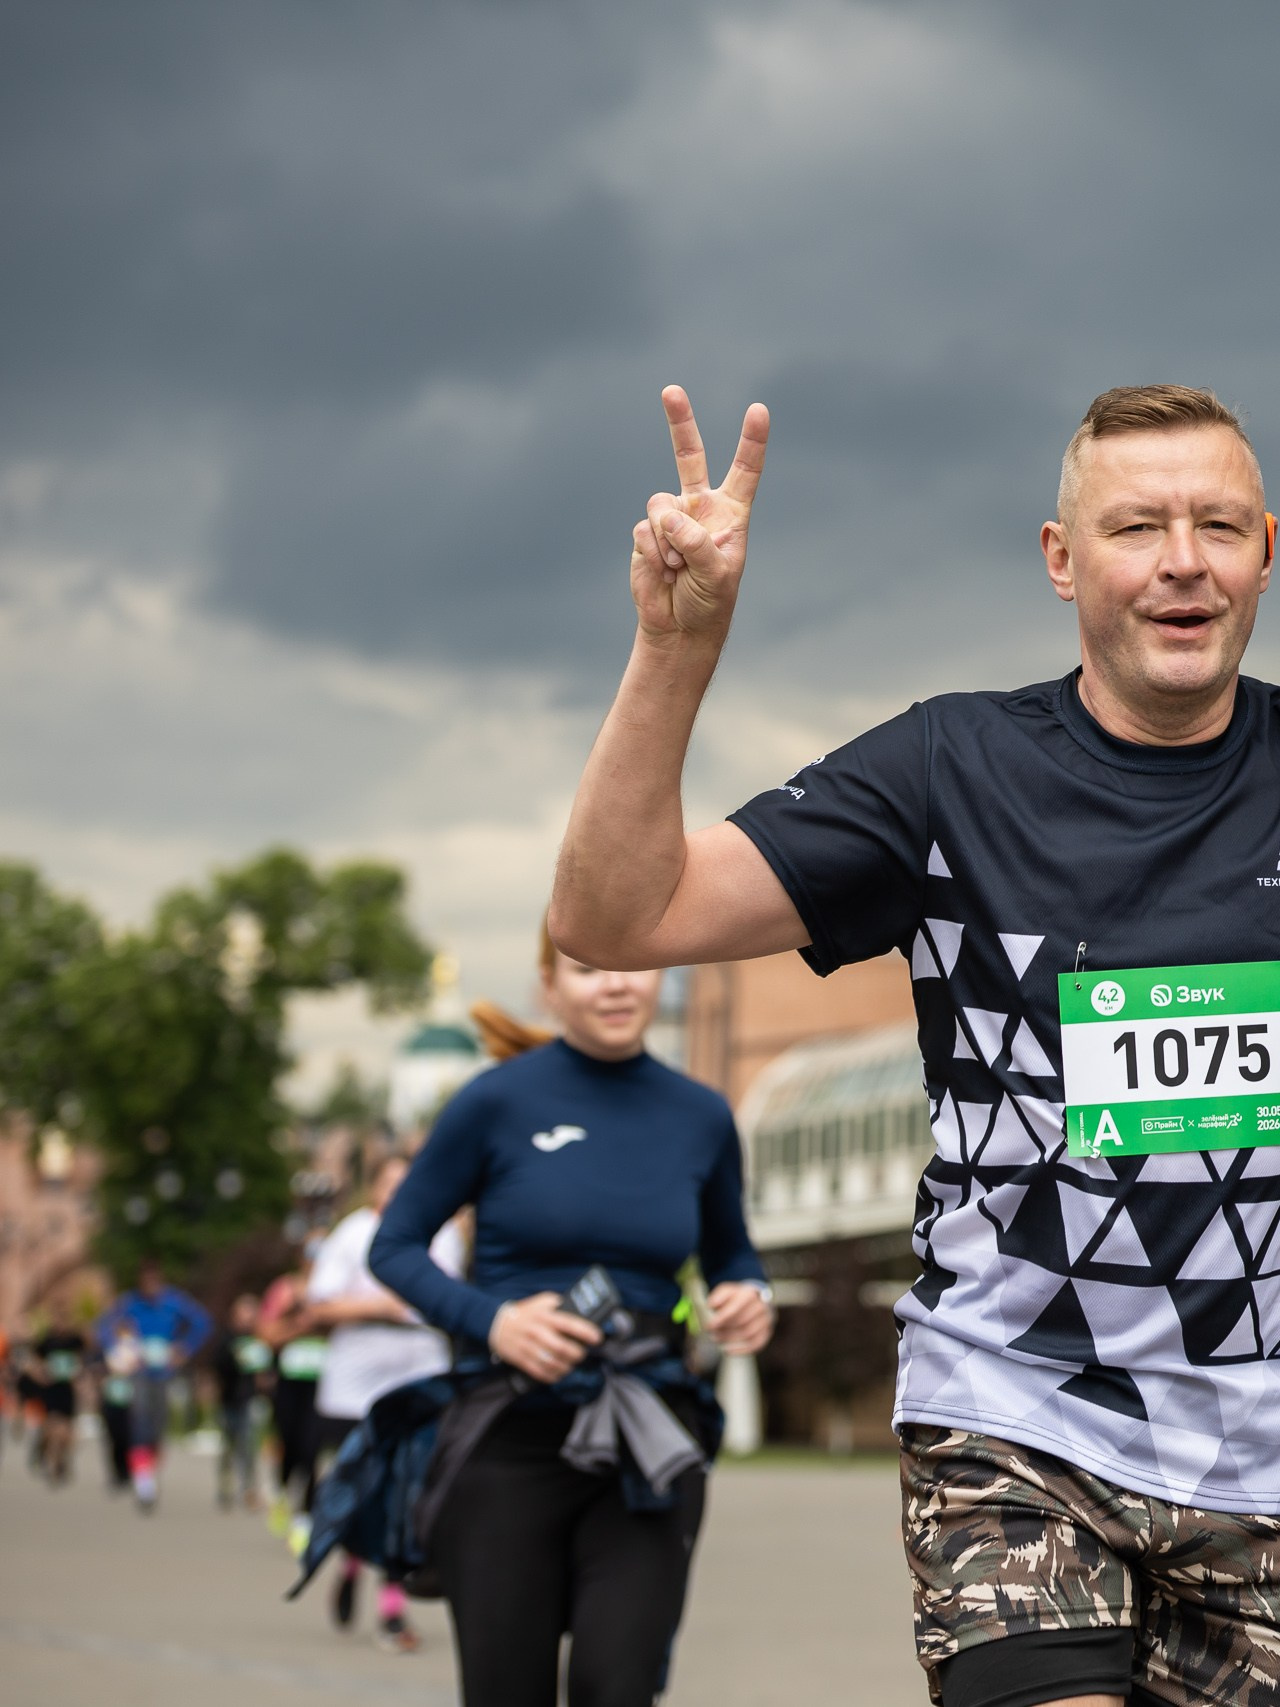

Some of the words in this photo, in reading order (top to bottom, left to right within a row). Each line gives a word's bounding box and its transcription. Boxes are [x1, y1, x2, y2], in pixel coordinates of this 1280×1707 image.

[1097, 987, 1119, 1004] 4,2
[1176, 985, 1226, 1005] Звук
[1113, 1023, 1271, 1090] 1075
[1257, 1118, 1280, 1131] 2026
